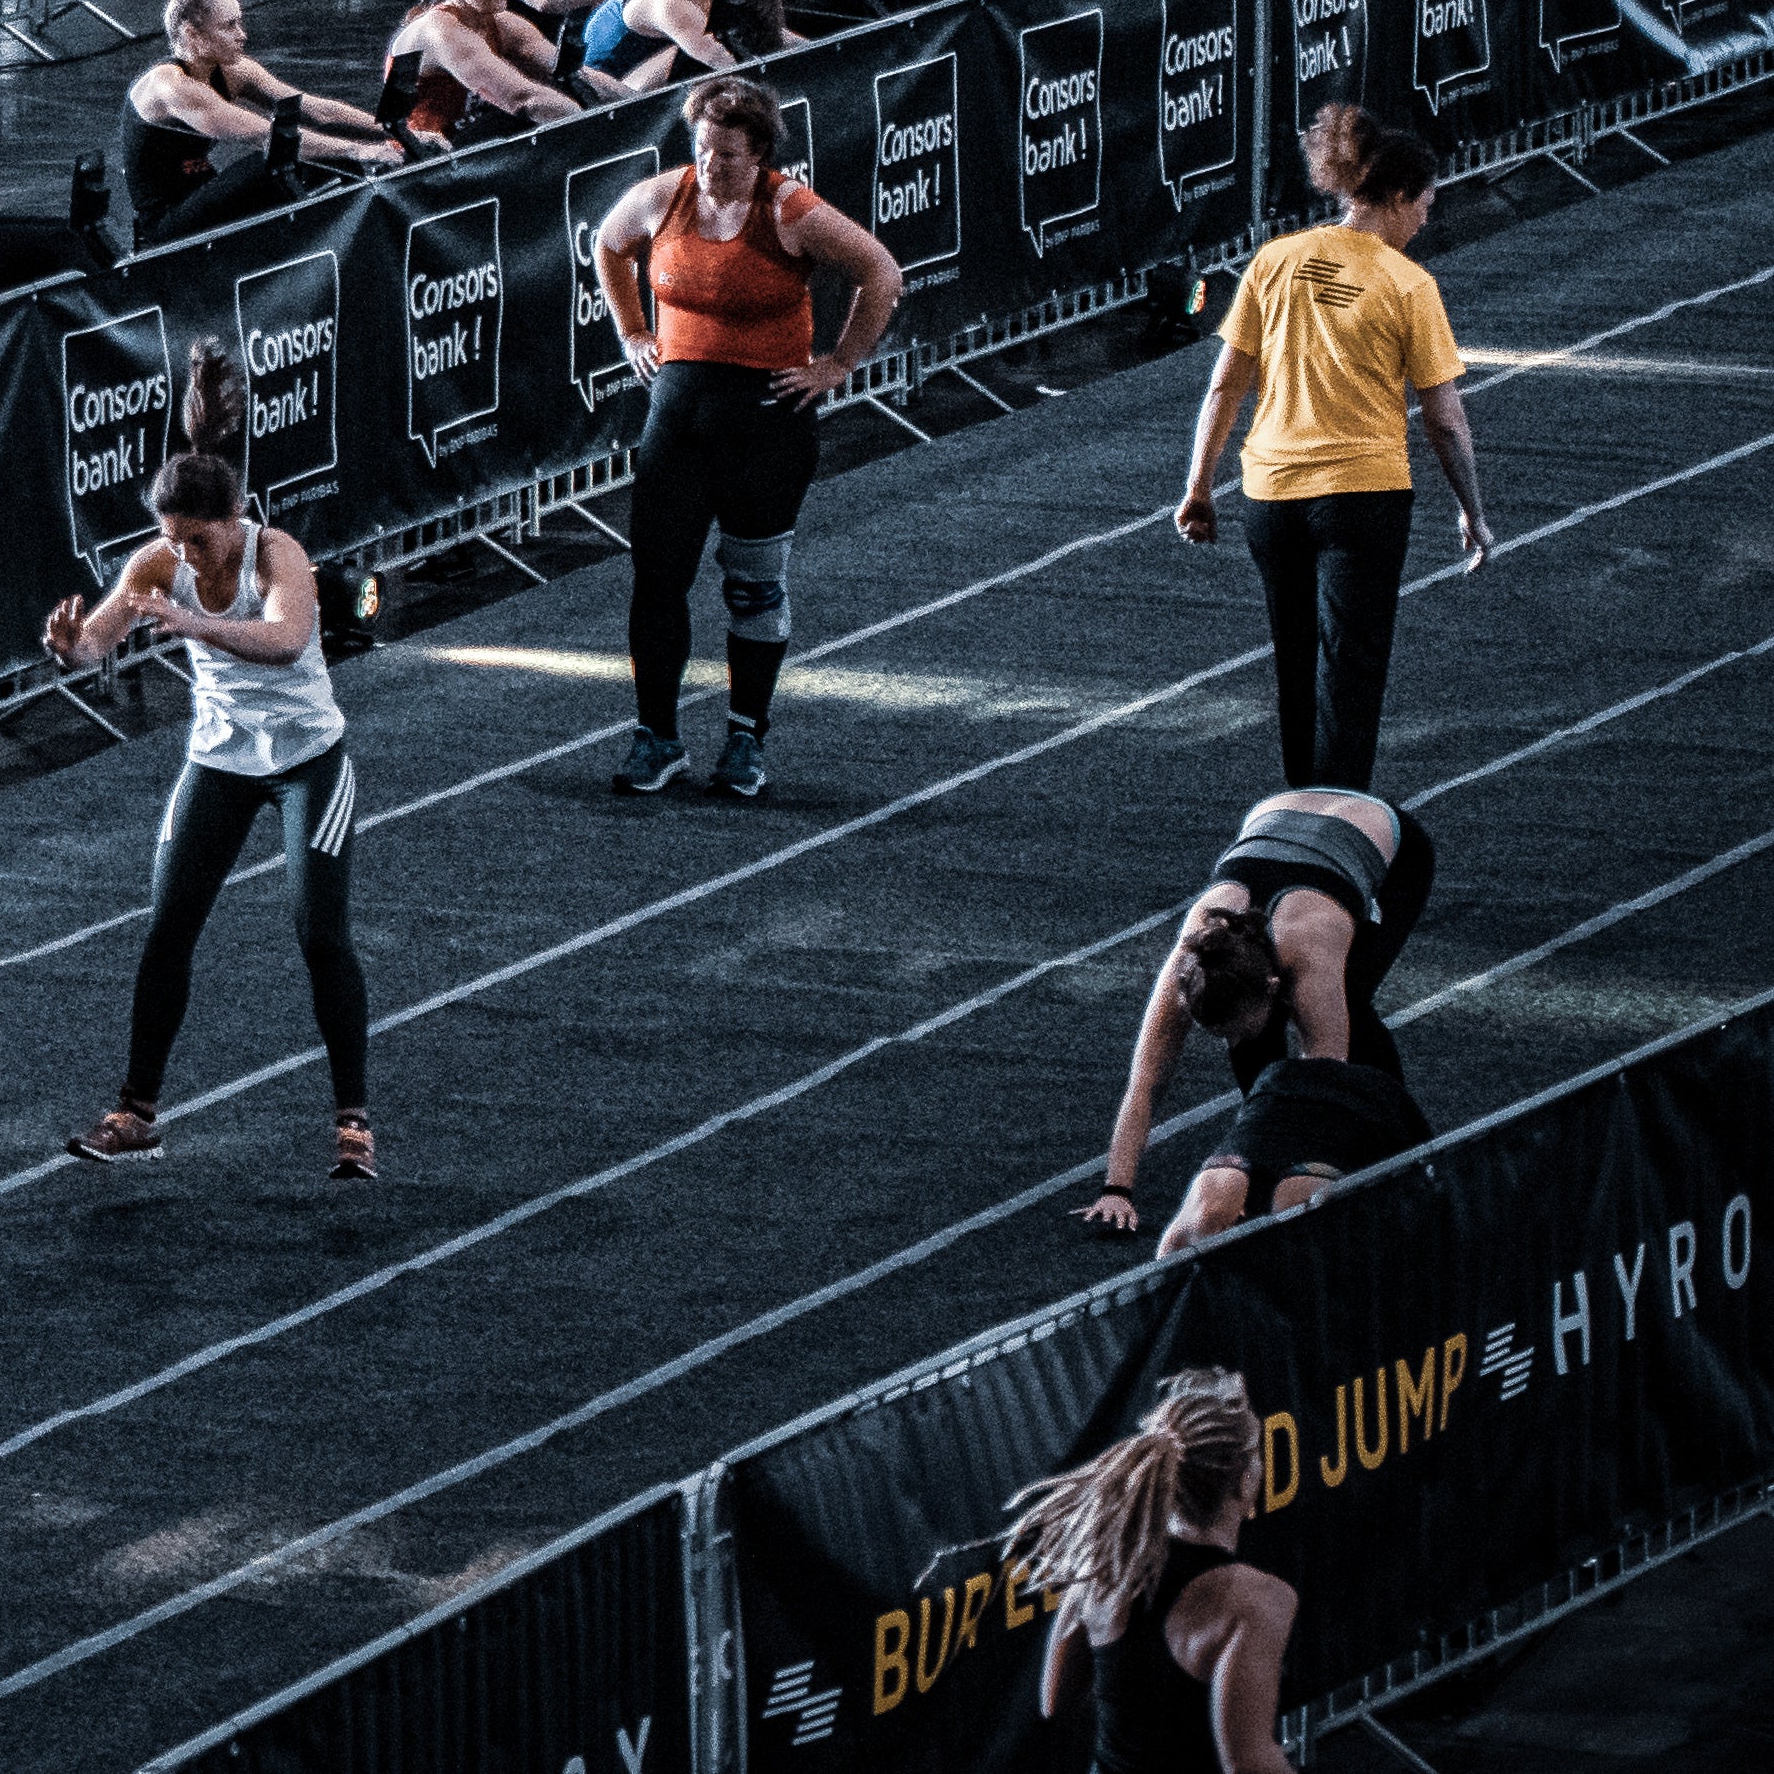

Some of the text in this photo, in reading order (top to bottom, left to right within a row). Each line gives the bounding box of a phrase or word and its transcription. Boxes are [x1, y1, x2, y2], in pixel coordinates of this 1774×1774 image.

[1164, 24, 1234, 81] Consors
[1026, 67, 1096, 122] Consors
[879, 109, 953, 168] Consors
[409, 256, 498, 322] Consors
[248, 313, 334, 380] Consors
[68, 360, 169, 435] Consors
[1551, 1192, 1754, 1378] HYRO
[1318, 1332, 1470, 1490] JUMP
